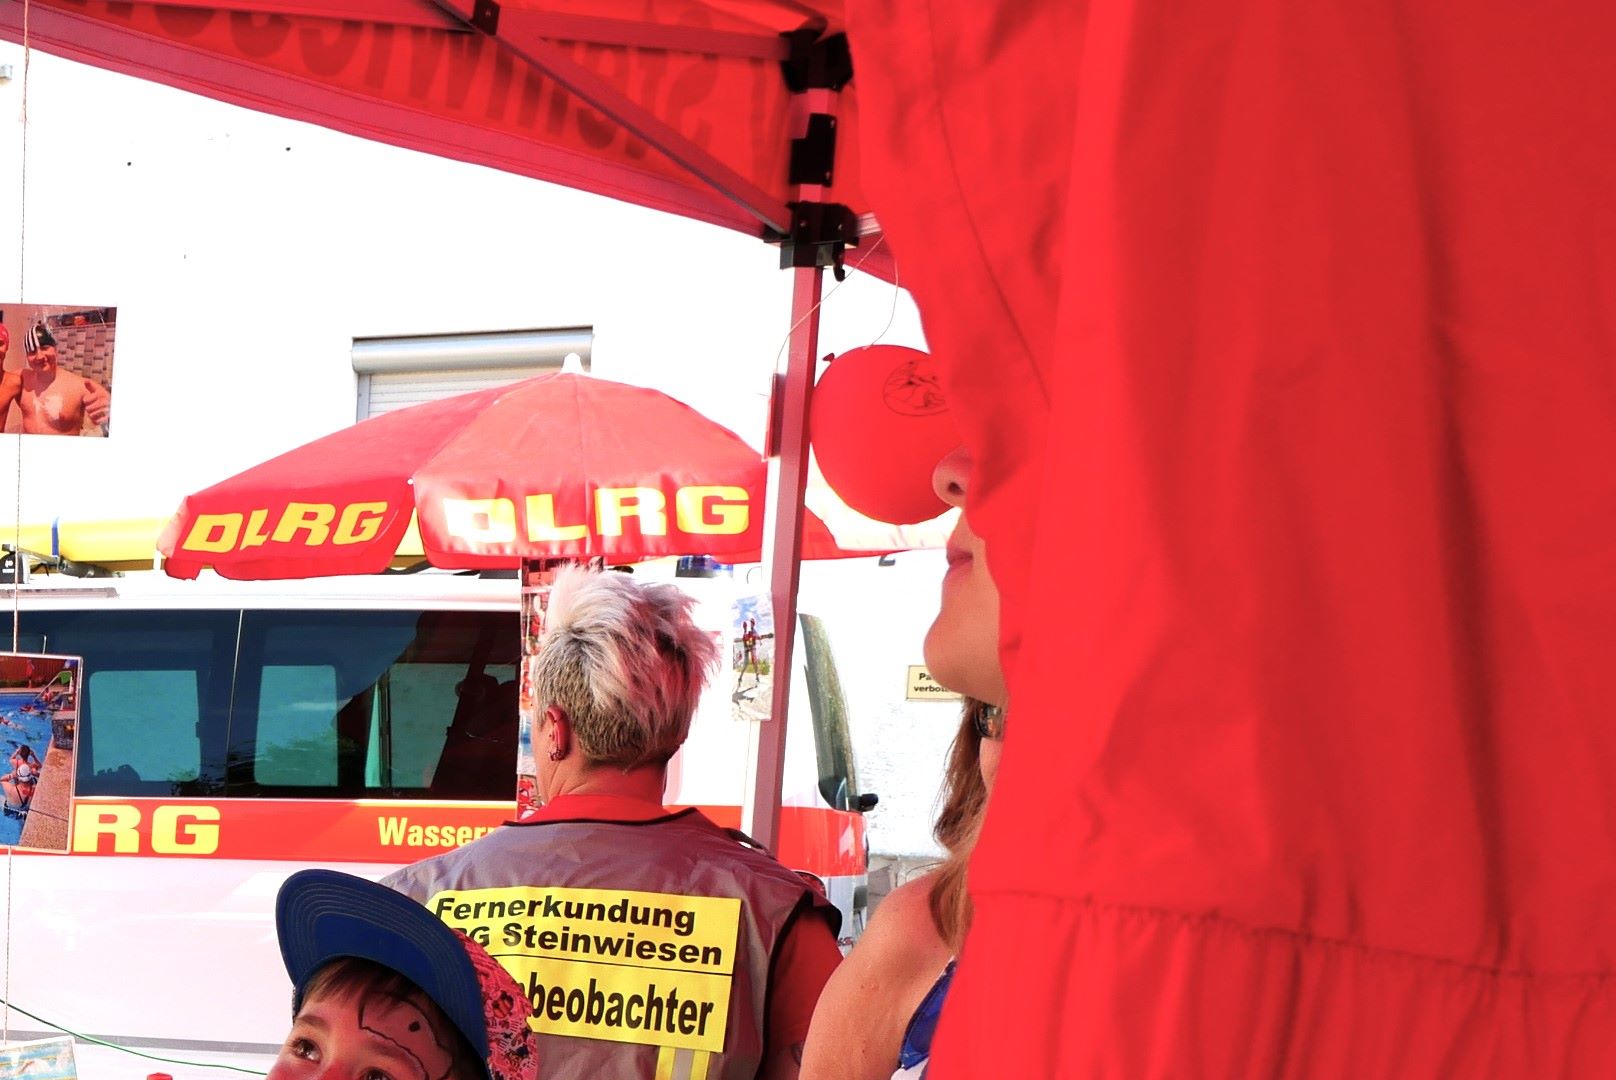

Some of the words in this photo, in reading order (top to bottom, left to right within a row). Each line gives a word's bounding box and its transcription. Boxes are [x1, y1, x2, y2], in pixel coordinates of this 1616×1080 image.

[181, 500, 388, 554] DLRG
[443, 485, 751, 548] DLRG
[378, 816, 496, 848] Wasser
[435, 894, 696, 937] Fernerkundung
[502, 921, 723, 967] Steinwiesen
[519, 971, 715, 1037] beobachter
